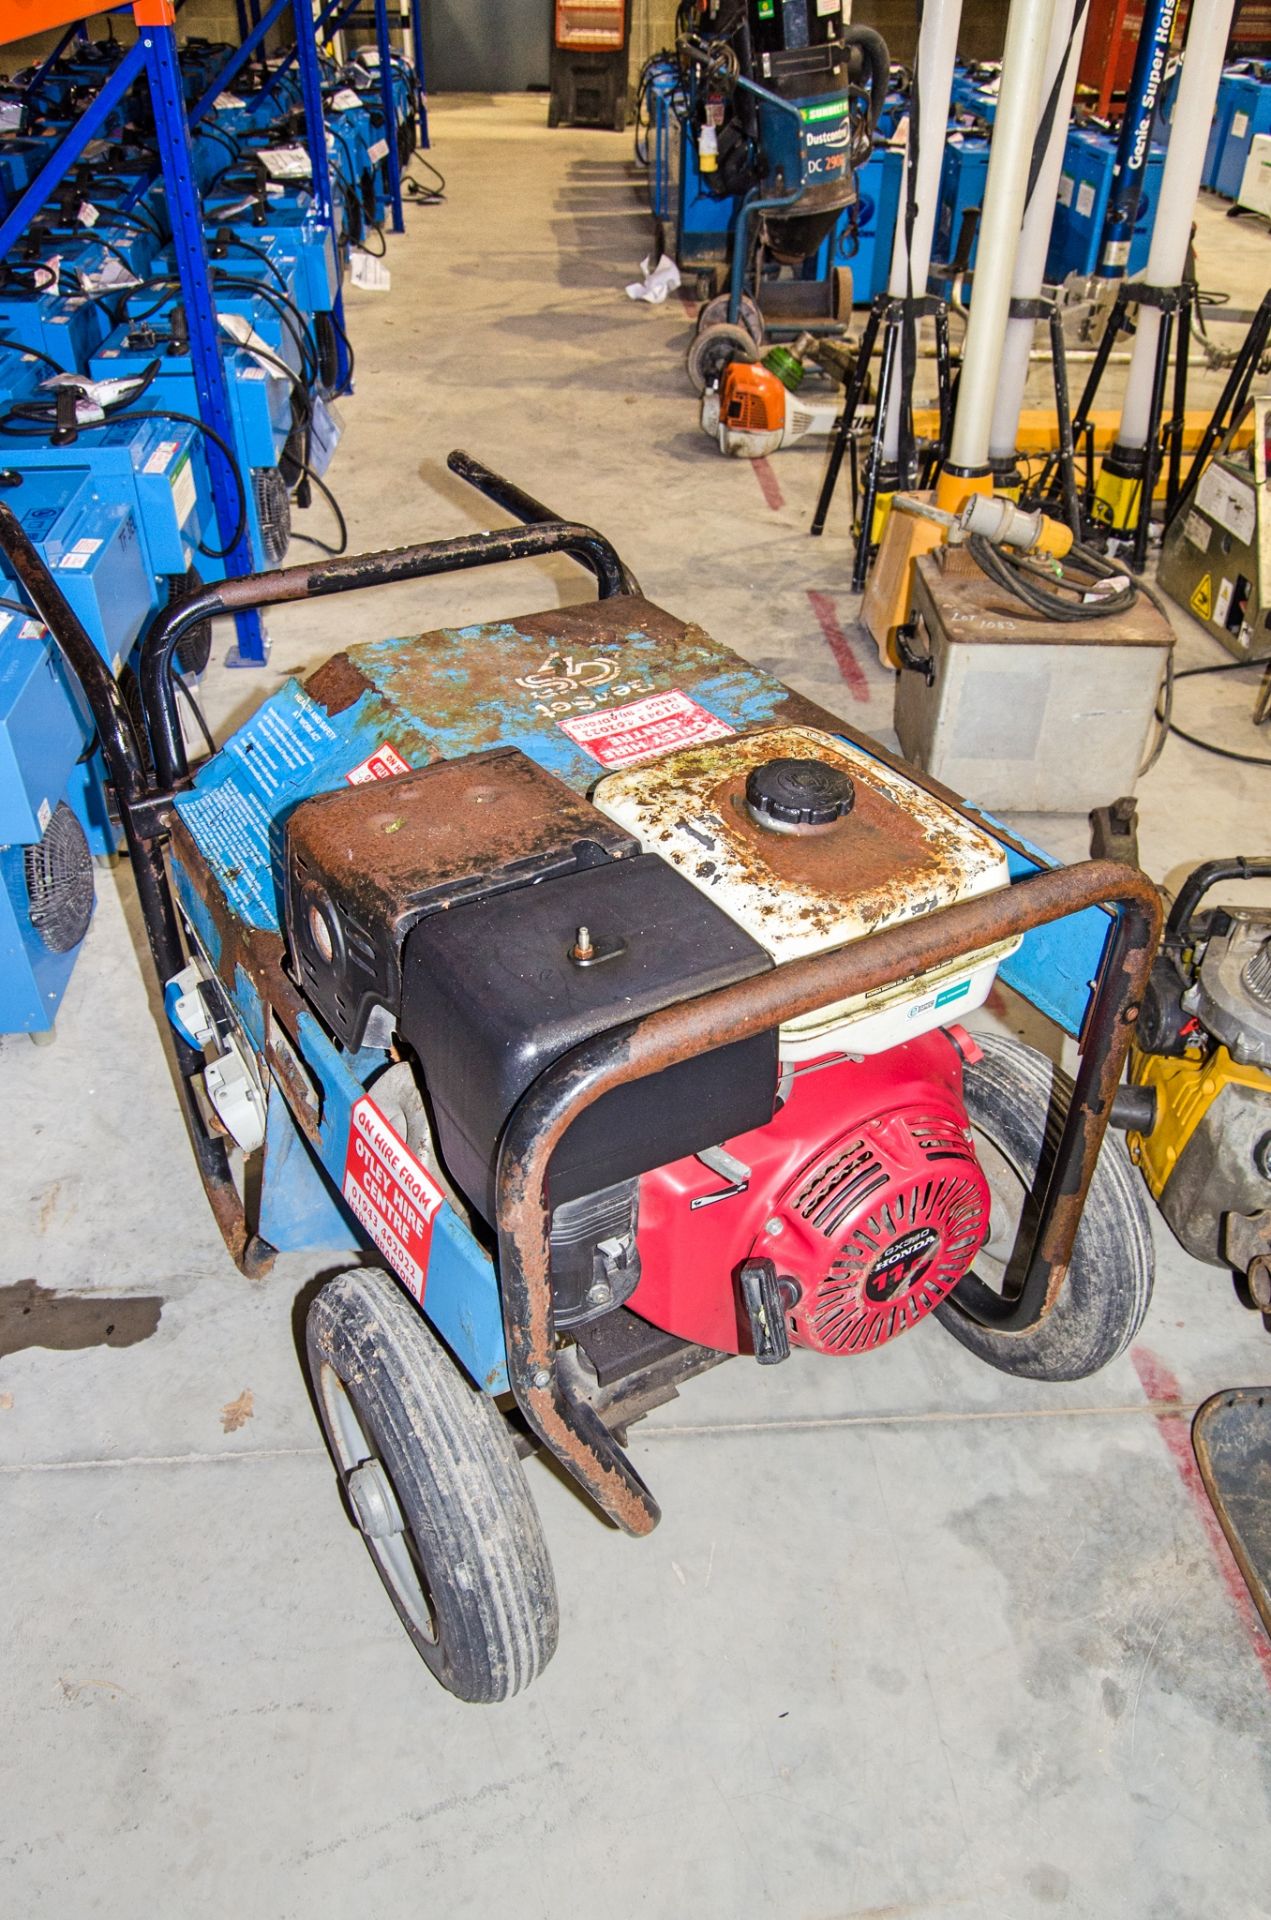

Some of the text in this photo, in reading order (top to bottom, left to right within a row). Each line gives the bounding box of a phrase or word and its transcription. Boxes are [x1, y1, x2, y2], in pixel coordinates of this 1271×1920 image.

[1128, 117, 1150, 170] Genie
[1142, 48, 1165, 109] Super
[808, 158, 822, 174] DC
[600, 721, 707, 760] OTLEY HIRE
[608, 719, 680, 746] CENTRE
[355, 1137, 424, 1240] OTLEY HIRE
[358, 1112, 431, 1211] ON HIRE FROM
[351, 1186, 416, 1279] 01943 462022
[363, 1171, 409, 1244] CENTRE
[874, 1235, 936, 1272] HONDA
